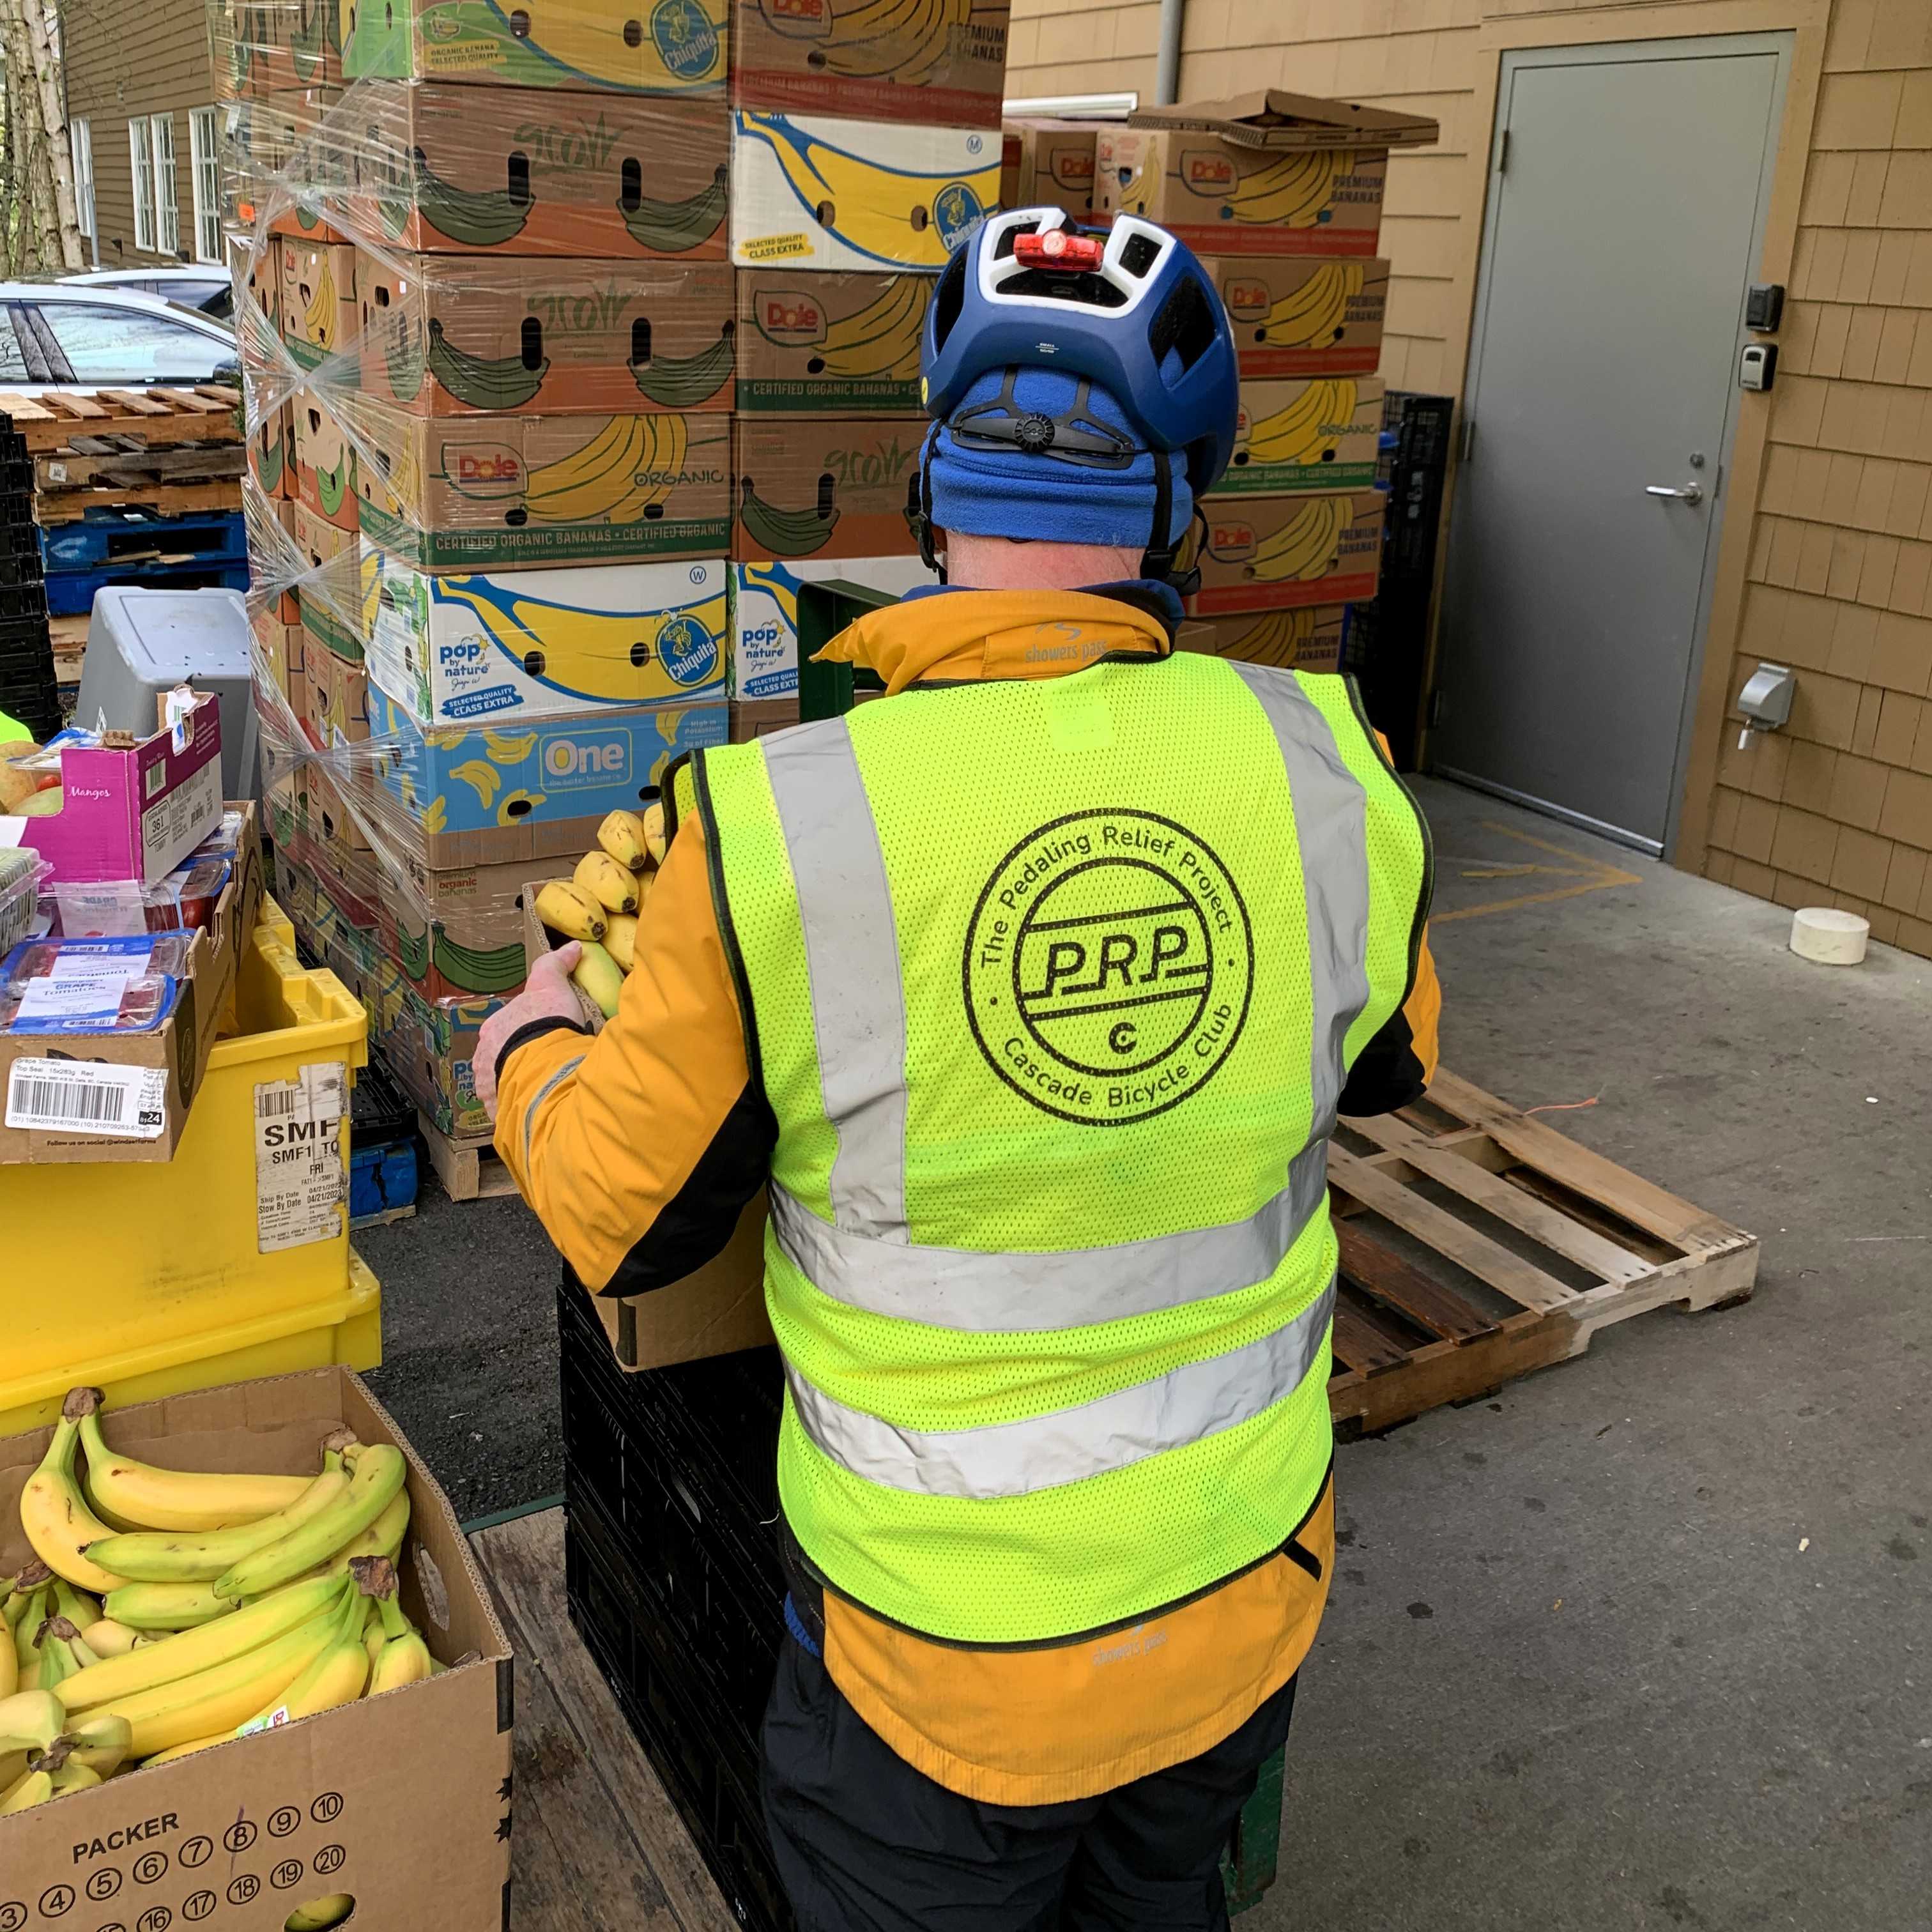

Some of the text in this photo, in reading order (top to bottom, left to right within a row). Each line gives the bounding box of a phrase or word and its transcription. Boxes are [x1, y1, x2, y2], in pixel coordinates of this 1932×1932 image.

[664, 31, 716, 71] Chiquita
[1191, 160, 1232, 180] Dole
[749, 243, 804, 258] CLASS EXTRA
[1233, 286, 1268, 305] Dole
[767, 302, 818, 327] Dole
[753, 383, 804, 395] CERTIFIED
[806, 383, 851, 395] ORGANIC
[853, 383, 900, 395] BANANAS
[1318, 423, 1377, 436] ORGANIC
[458, 453, 519, 479] Dole
[634, 470, 724, 487] ORGANIC
[436, 523, 726, 551] CERTIFIED ORGANIC BANANAS CERTIFIED ORGANIC
[1214, 527, 1252, 546] Dole
[742, 629, 778, 647] pop
[440, 644, 480, 664] pop
[668, 640, 718, 682] Chiquita
[746, 646, 784, 659] nature
[1024, 640, 1108, 663] showers pass
[445, 665, 489, 677] nature
[750, 671, 799, 687] SELECTED QUALI
[753, 680, 799, 695] CLASS EXT
[449, 687, 512, 708] SELECTED QUALITY
[454, 695, 514, 716] CLASS EXTRA
[545, 740, 624, 776] One
[67, 786, 111, 801] Mangos
[152, 815, 164, 833] 361
[436, 870, 476, 881] premium
[439, 878, 478, 889] organic
[438, 887, 477, 898] bananas
[981, 825, 1233, 969] The Pedaling Relief Project
[1045, 925, 1189, 995] PRP
[1004, 1002, 1232, 1108] Cascade Bicycle Club
[468, 1112, 486, 1121] ORGA
[272, 1146, 311, 1164] SMF1
[309, 1162, 324, 1175] FRI
[258, 1188, 343, 1214] Stow By Date 04/21/2023
[286, 1191, 300, 1199] Date
[1092, 1639, 1140, 1667] showers
[72, 1812, 180, 1864] PACKER
[1, 1795, 339, 1929] 3 4 5 6 7 8 9 10
[144, 1848, 340, 1932] 16 17 18 19 20
